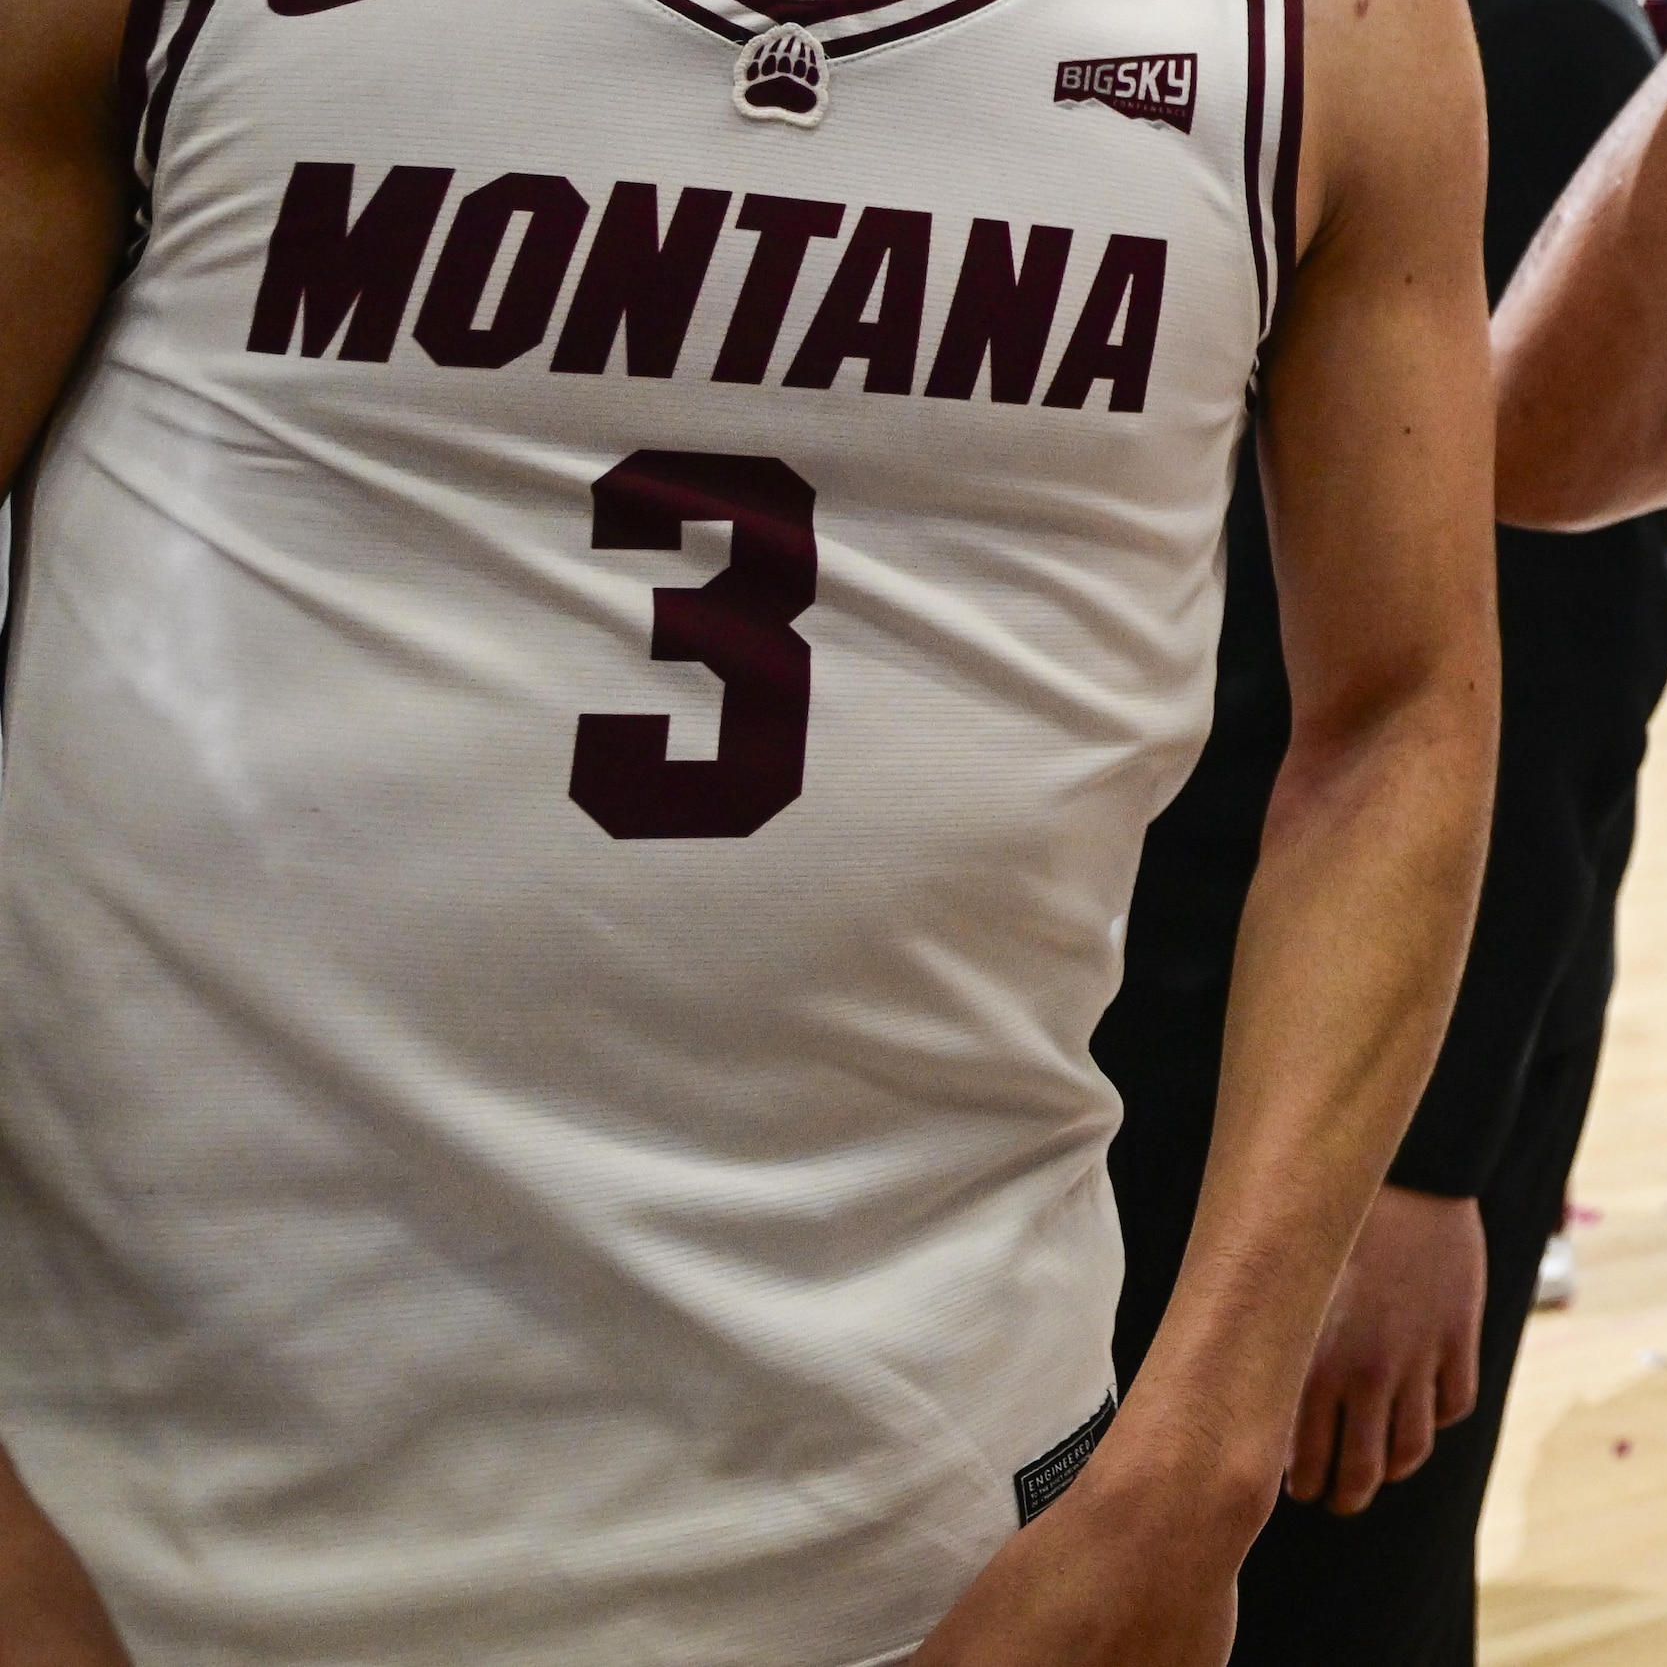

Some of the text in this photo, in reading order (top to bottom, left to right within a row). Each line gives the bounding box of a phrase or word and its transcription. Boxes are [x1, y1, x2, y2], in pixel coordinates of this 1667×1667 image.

[247, 161, 1167, 414] MONTANA
[568, 448, 818, 841] 3
[1028, 1439, 1092, 1491] ENGINEERED
